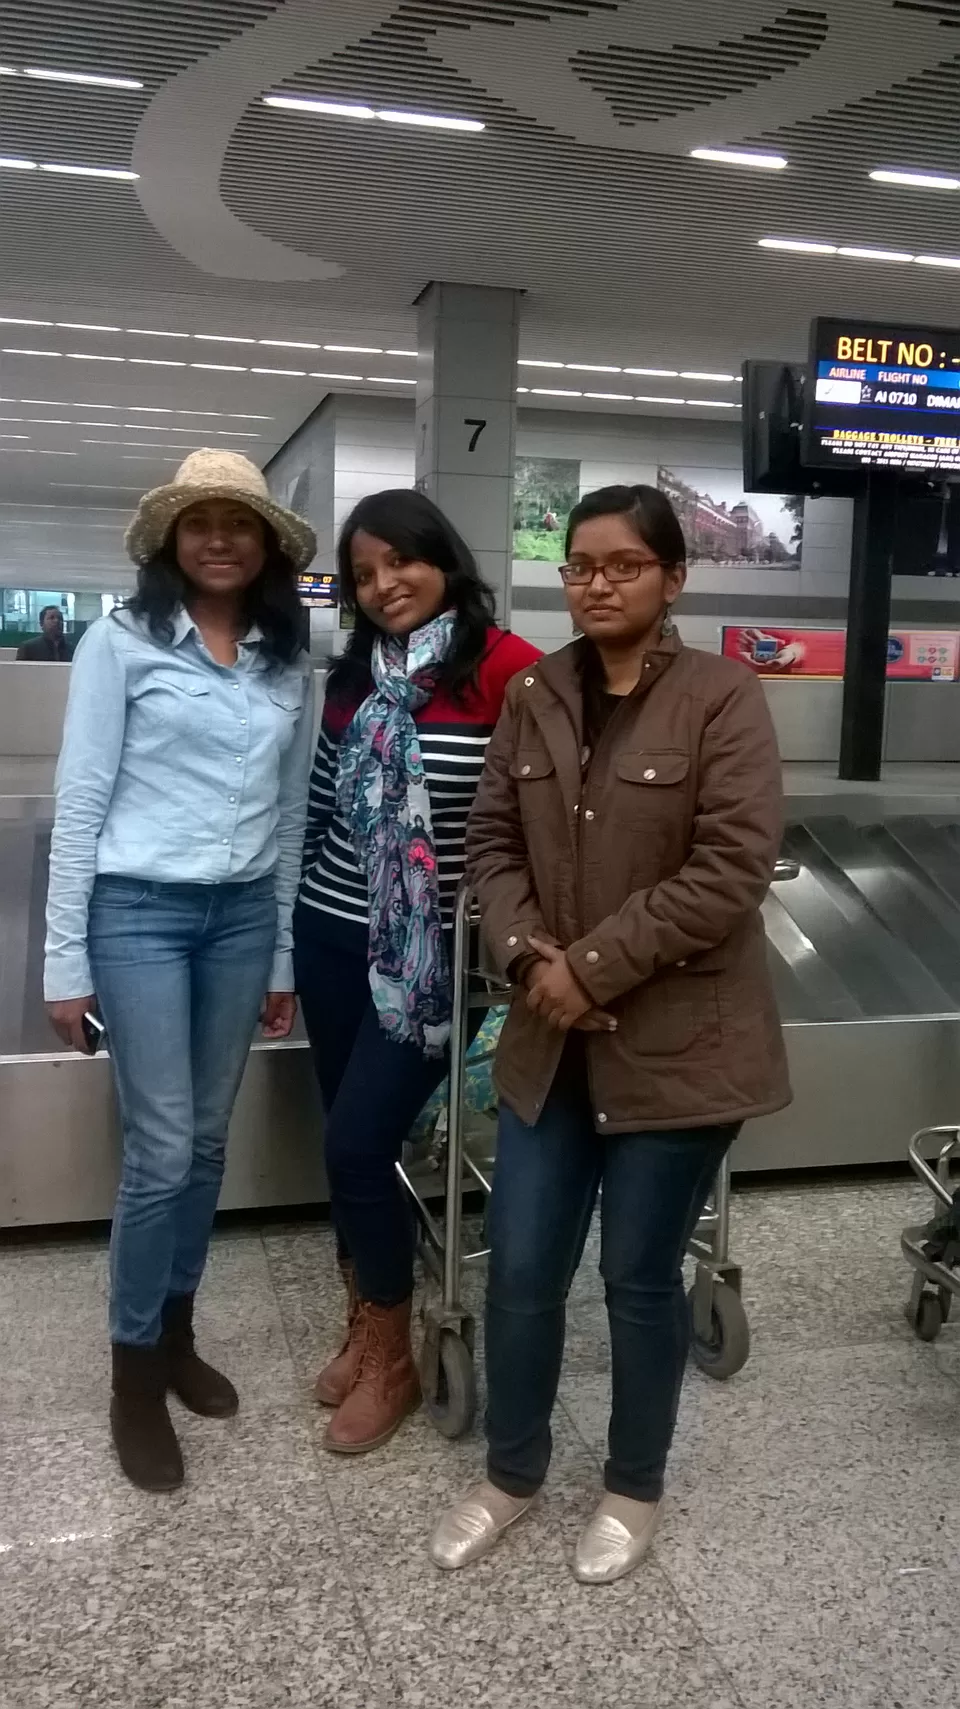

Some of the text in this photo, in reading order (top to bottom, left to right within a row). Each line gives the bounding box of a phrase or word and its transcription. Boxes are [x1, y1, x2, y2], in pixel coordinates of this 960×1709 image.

[837, 336, 893, 363] BELT
[897, 342, 934, 367] NO
[829, 367, 867, 380] AIRLINE
[878, 371, 928, 385] FLIGHT NO
[874, 390, 960, 409] AI 0710 DIMA
[464, 419, 486, 452] 7
[833, 429, 876, 442] BAGGAGE
[878, 432, 924, 444] TROLLEYS
[322, 576, 333, 584] 07
